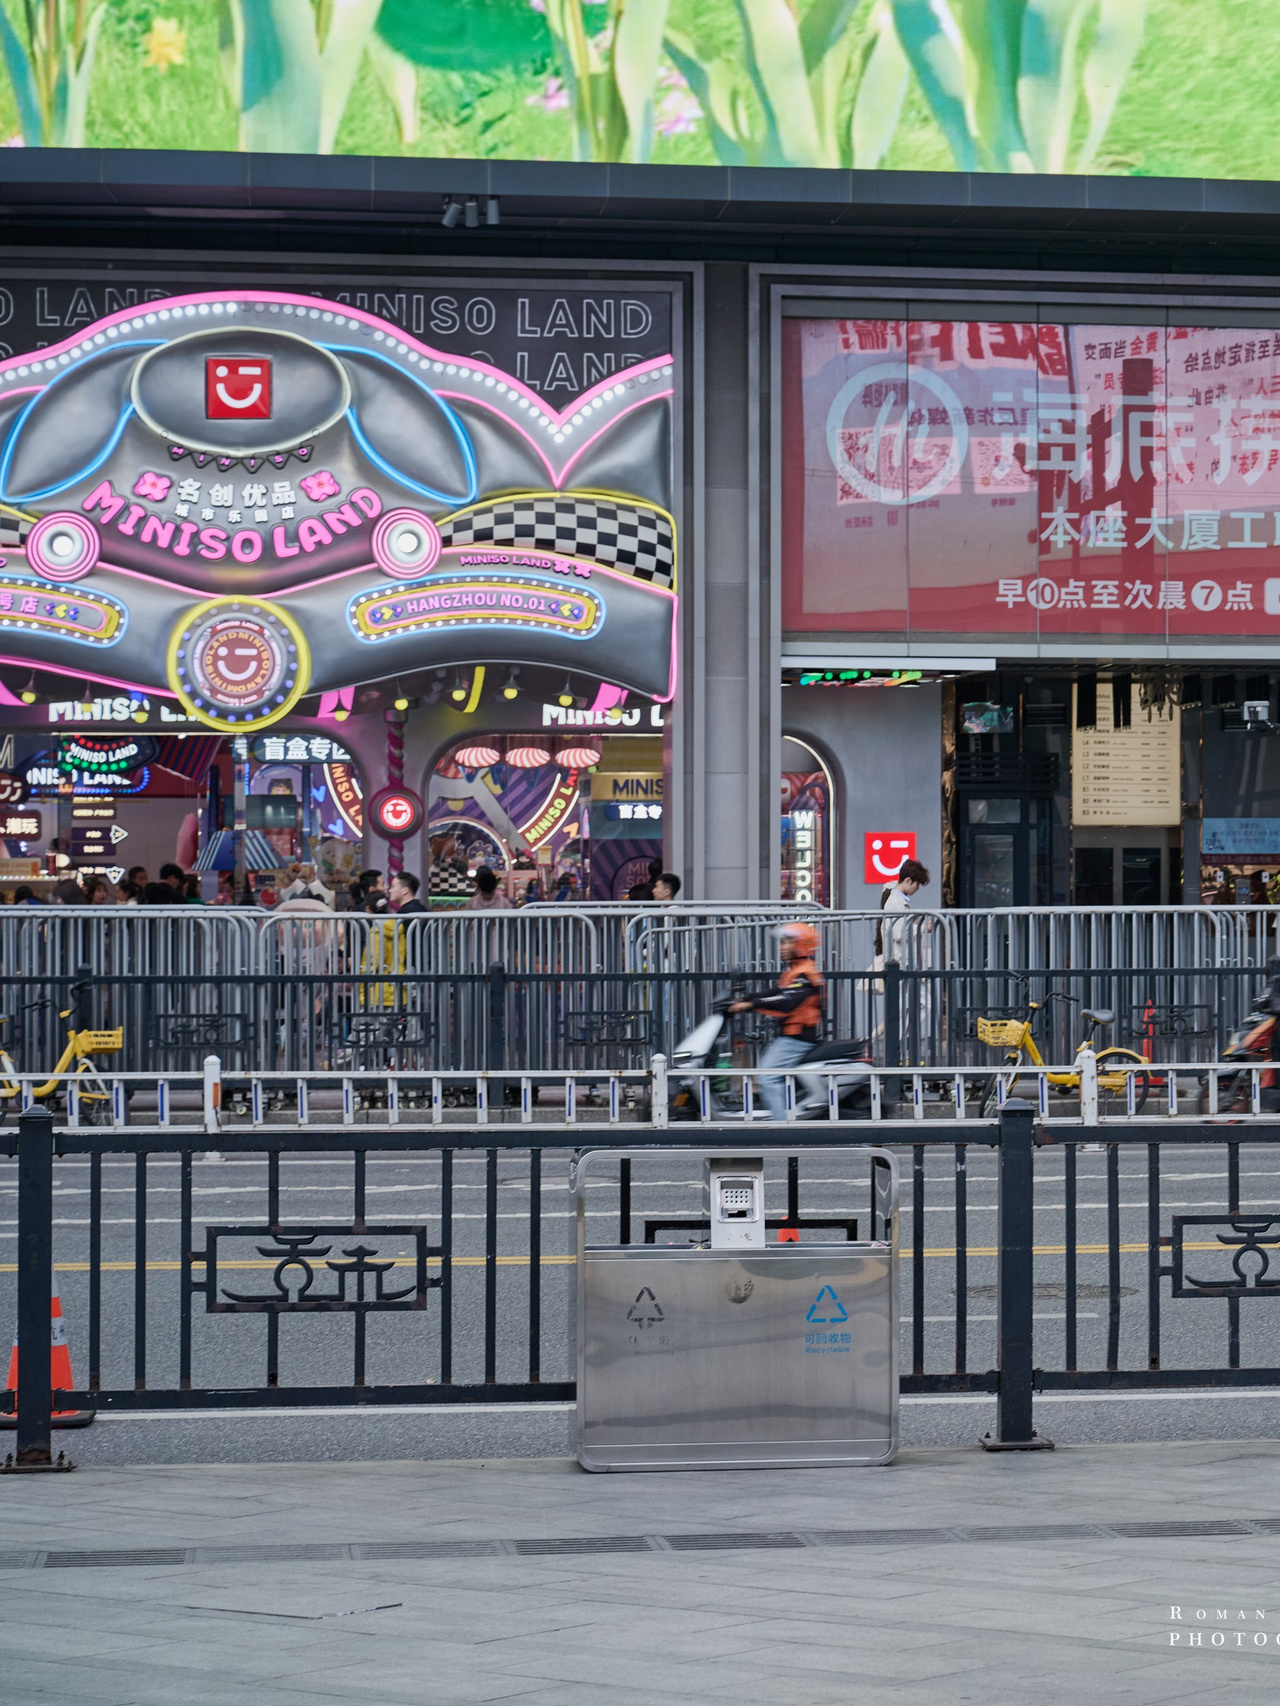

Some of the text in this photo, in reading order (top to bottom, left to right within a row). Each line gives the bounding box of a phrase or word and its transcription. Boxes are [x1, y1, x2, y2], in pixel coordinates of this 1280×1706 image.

[36, 287, 171, 327] LAN
[516, 298, 652, 338] LAND
[176, 478, 296, 508] 名创优品
[82, 480, 383, 563] MINISO LAND
[460, 554, 552, 570] MINISO LAND
[406, 592, 547, 614] HANGZHOU NO.01
[70, 743, 138, 763] MINISO LAND
[613, 778, 664, 796] MINIS
[524, 797, 567, 845] MINISO
[804, 1333, 851, 1345] 可回收物
[804, 1346, 851, 1355] Recyclable
